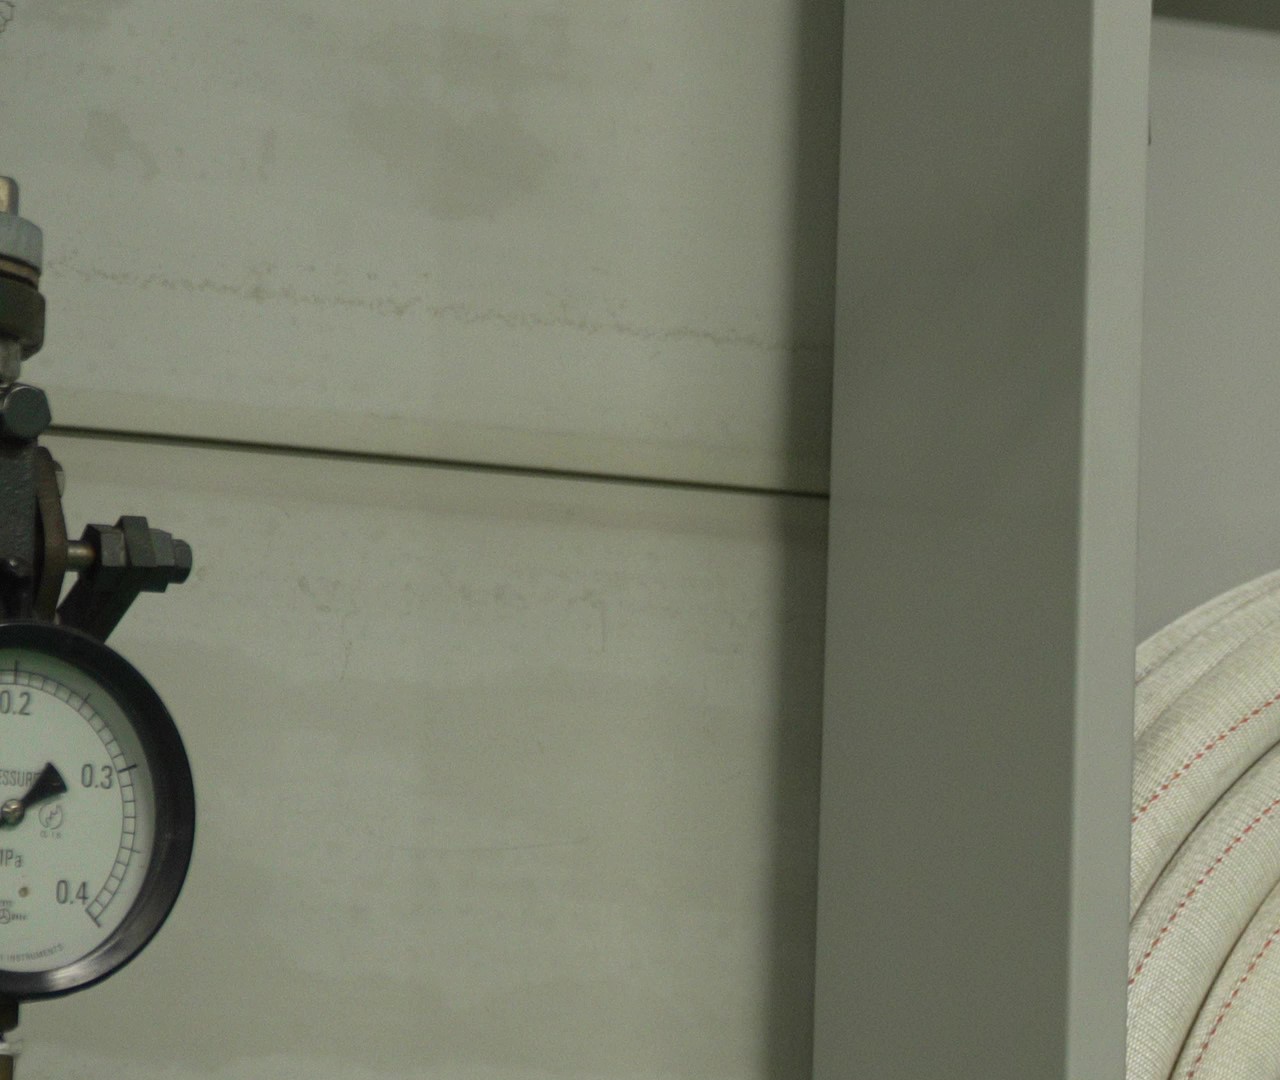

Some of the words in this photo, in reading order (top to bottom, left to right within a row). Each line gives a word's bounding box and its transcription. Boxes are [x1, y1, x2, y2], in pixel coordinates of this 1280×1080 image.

[0, 690, 31, 715] 0.2
[81, 764, 113, 789] 0.3
[56, 880, 89, 905] 0.4
